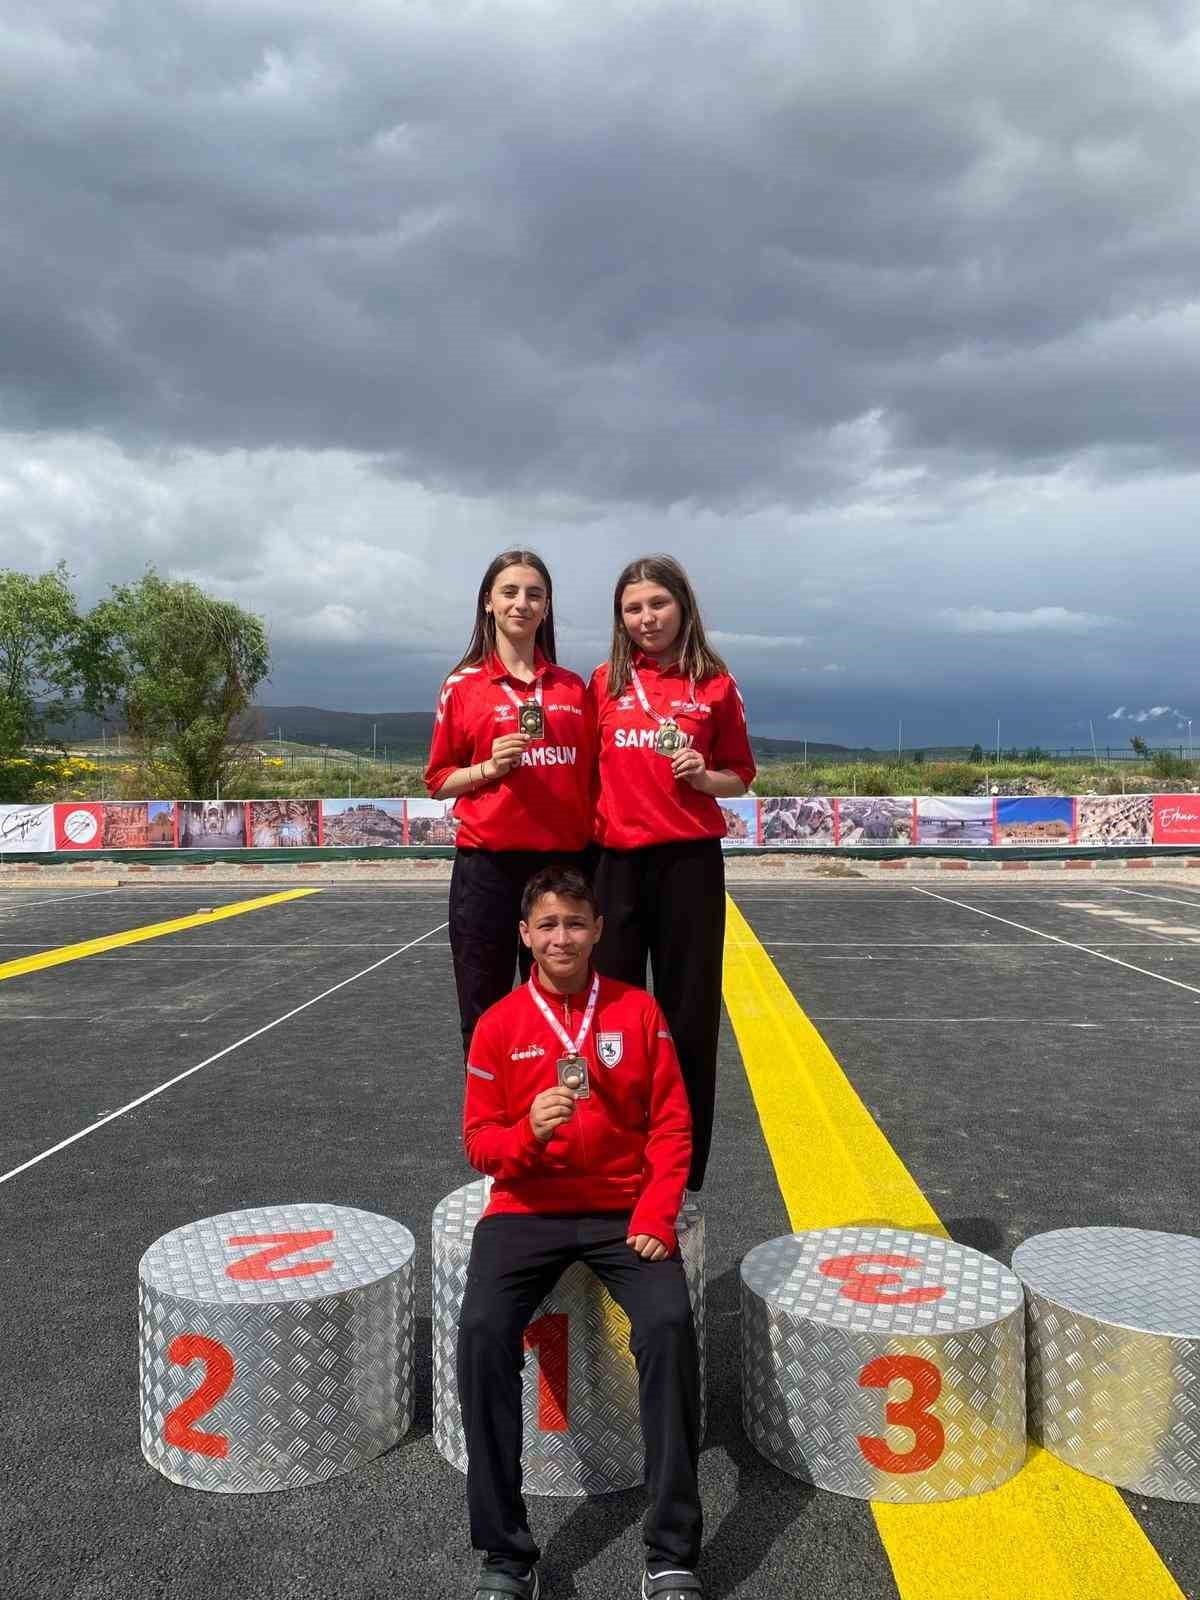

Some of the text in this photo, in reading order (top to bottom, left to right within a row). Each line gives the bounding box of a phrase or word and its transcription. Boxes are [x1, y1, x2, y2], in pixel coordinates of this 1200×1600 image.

[614, 728, 694, 749] SAMN
[164, 1333, 235, 1459] 2
[523, 1313, 570, 1433] 1
[856, 1353, 945, 1475] 3
